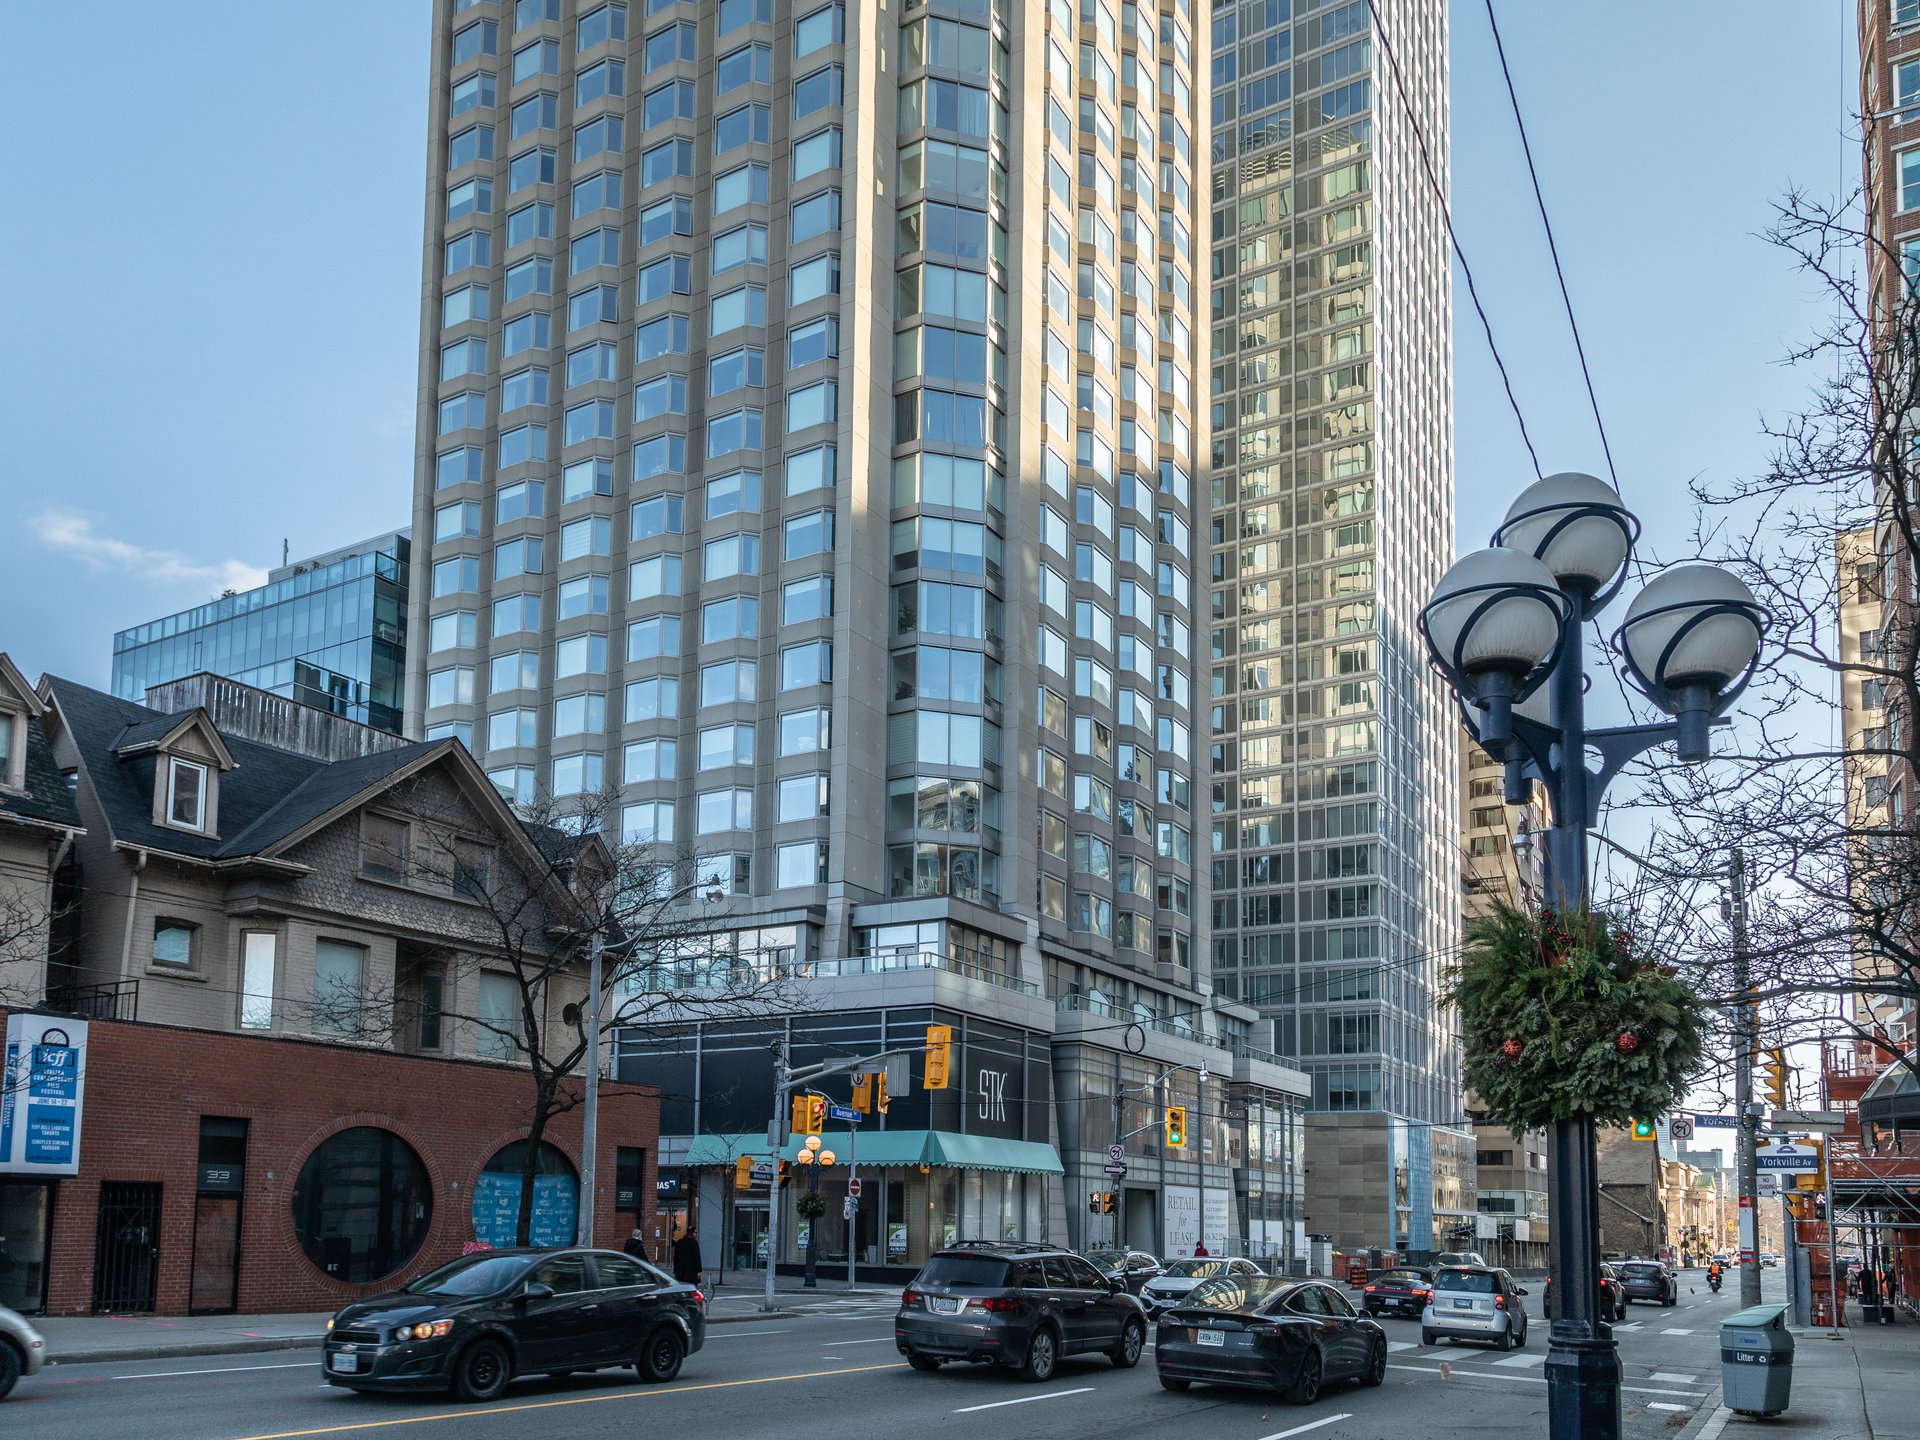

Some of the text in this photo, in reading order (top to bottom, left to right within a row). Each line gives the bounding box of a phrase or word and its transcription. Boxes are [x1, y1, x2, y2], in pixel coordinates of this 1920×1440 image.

[979, 1069, 1006, 1122] STK
[836, 1109, 853, 1119] Avenue
[1702, 1116, 1738, 1127] Yorkvill
[1762, 1157, 1801, 1166] Yorkville
[206, 1170, 230, 1179] 33
[1168, 1195, 1196, 1210] RETAIL
[1177, 1212, 1187, 1231] for
[1170, 1232, 1194, 1246] LEASE
[1737, 1352, 1755, 1362] Litter
